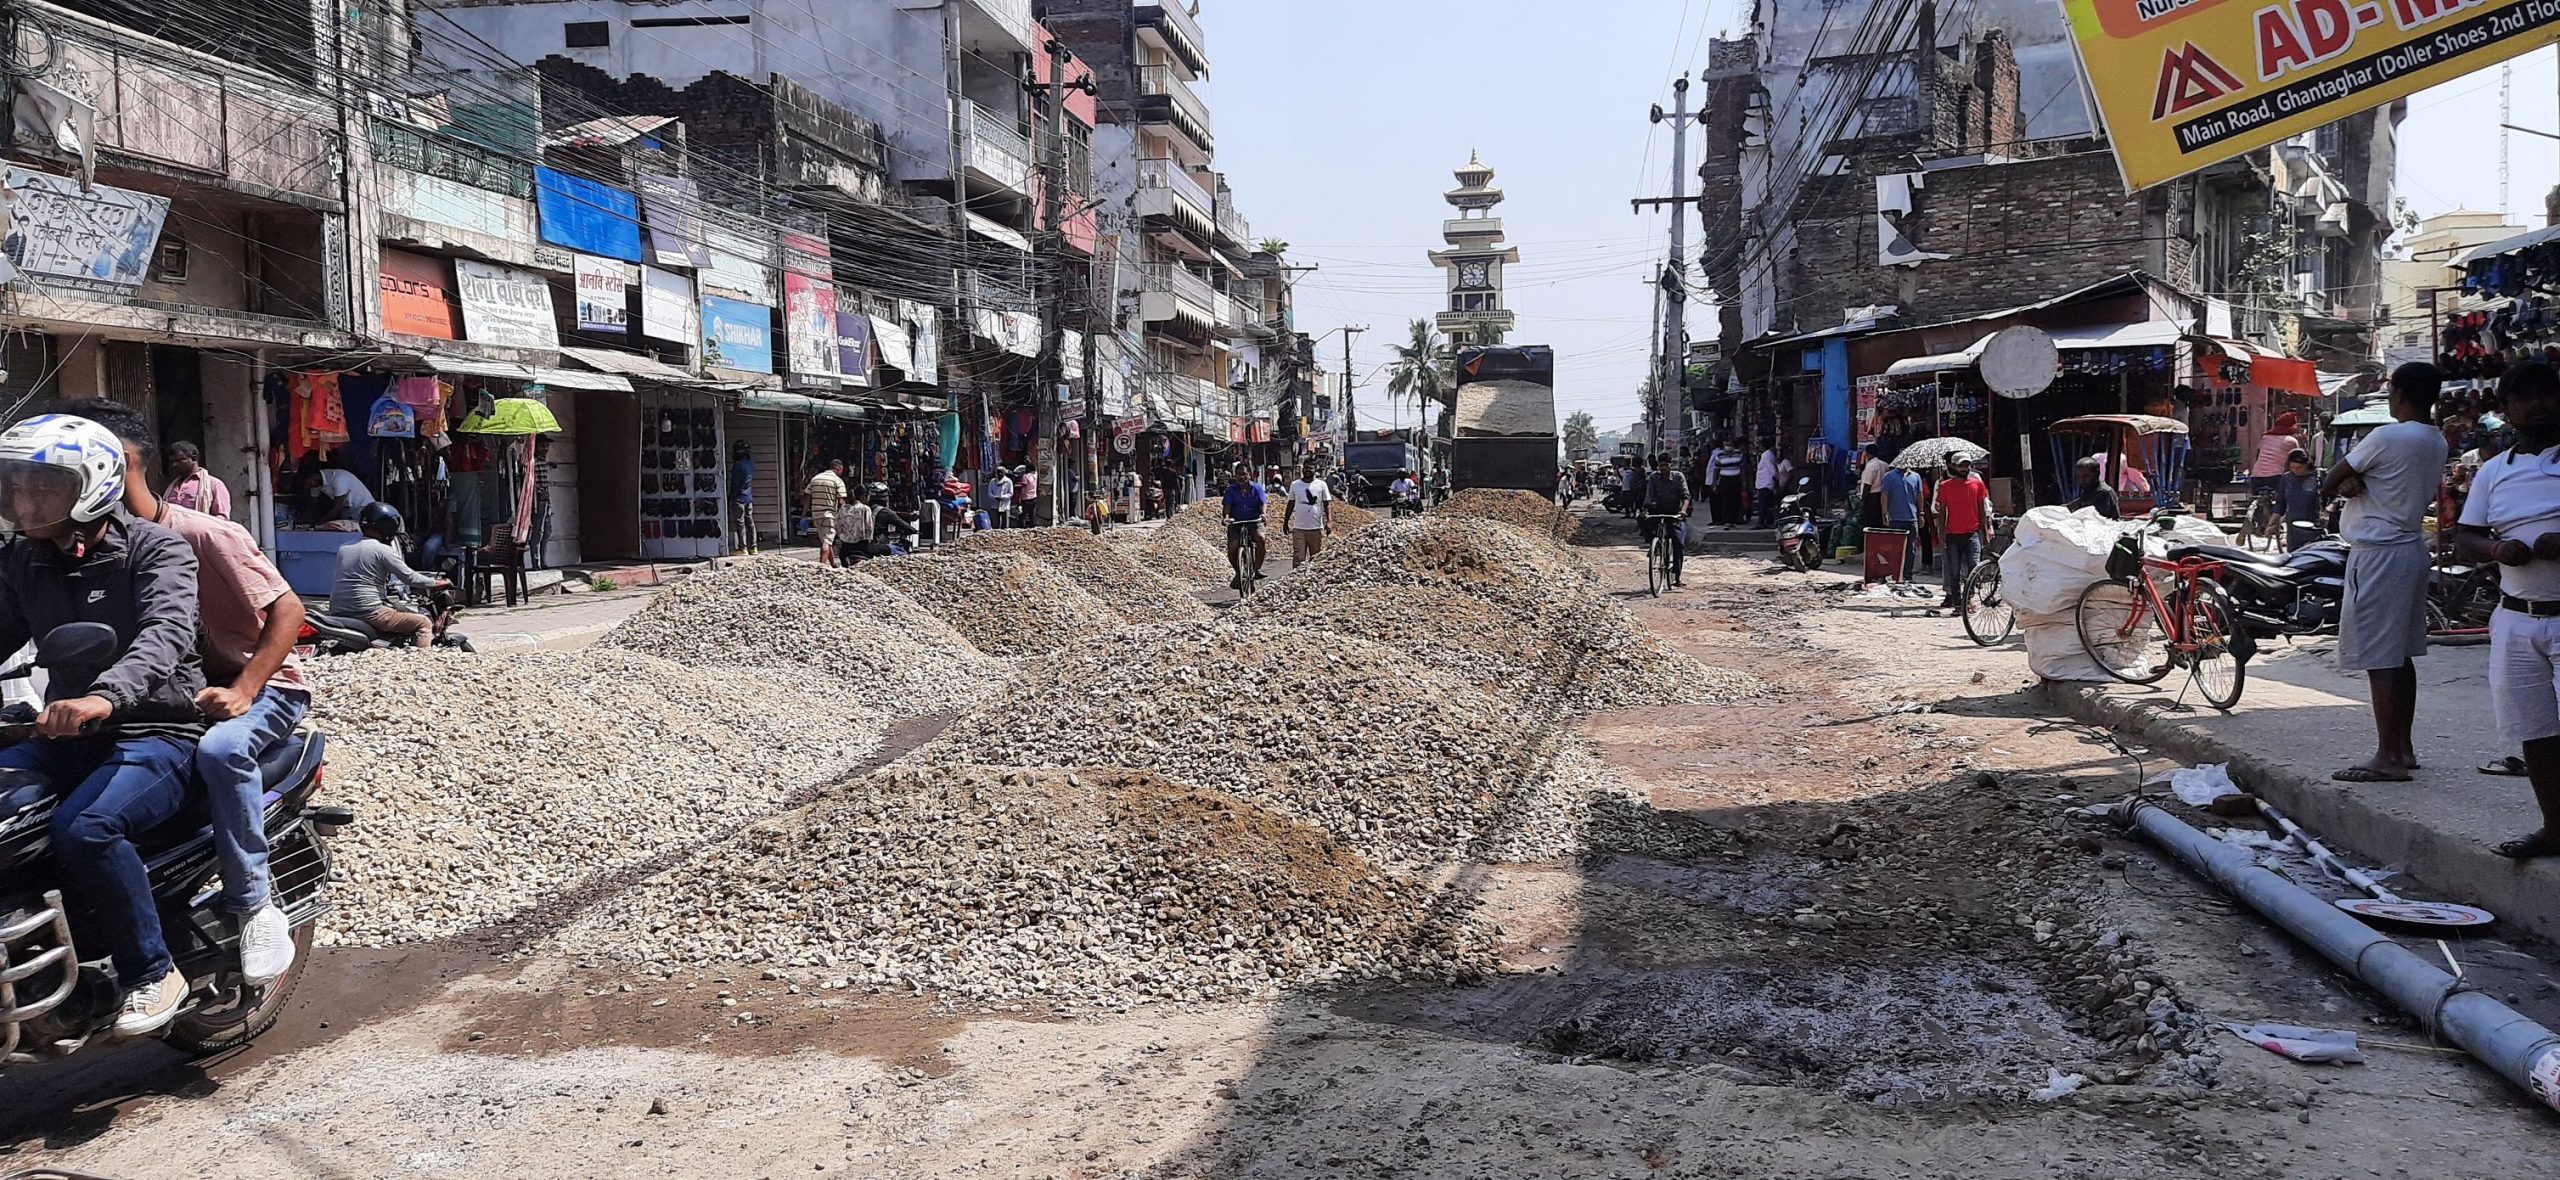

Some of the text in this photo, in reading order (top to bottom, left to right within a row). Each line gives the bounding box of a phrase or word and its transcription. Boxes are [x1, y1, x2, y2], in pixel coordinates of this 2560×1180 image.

[2182, 119, 2226, 147] Main
[2226, 100, 2275, 133] Road,
[2276, 65, 2373, 113] Ghantaghar
[2377, 42, 2433, 80] (Doller
[2435, 26, 2488, 56] Shoes
[2488, 6, 2525, 36] 2nd
[724, 322, 762, 348] SHIKHAR
